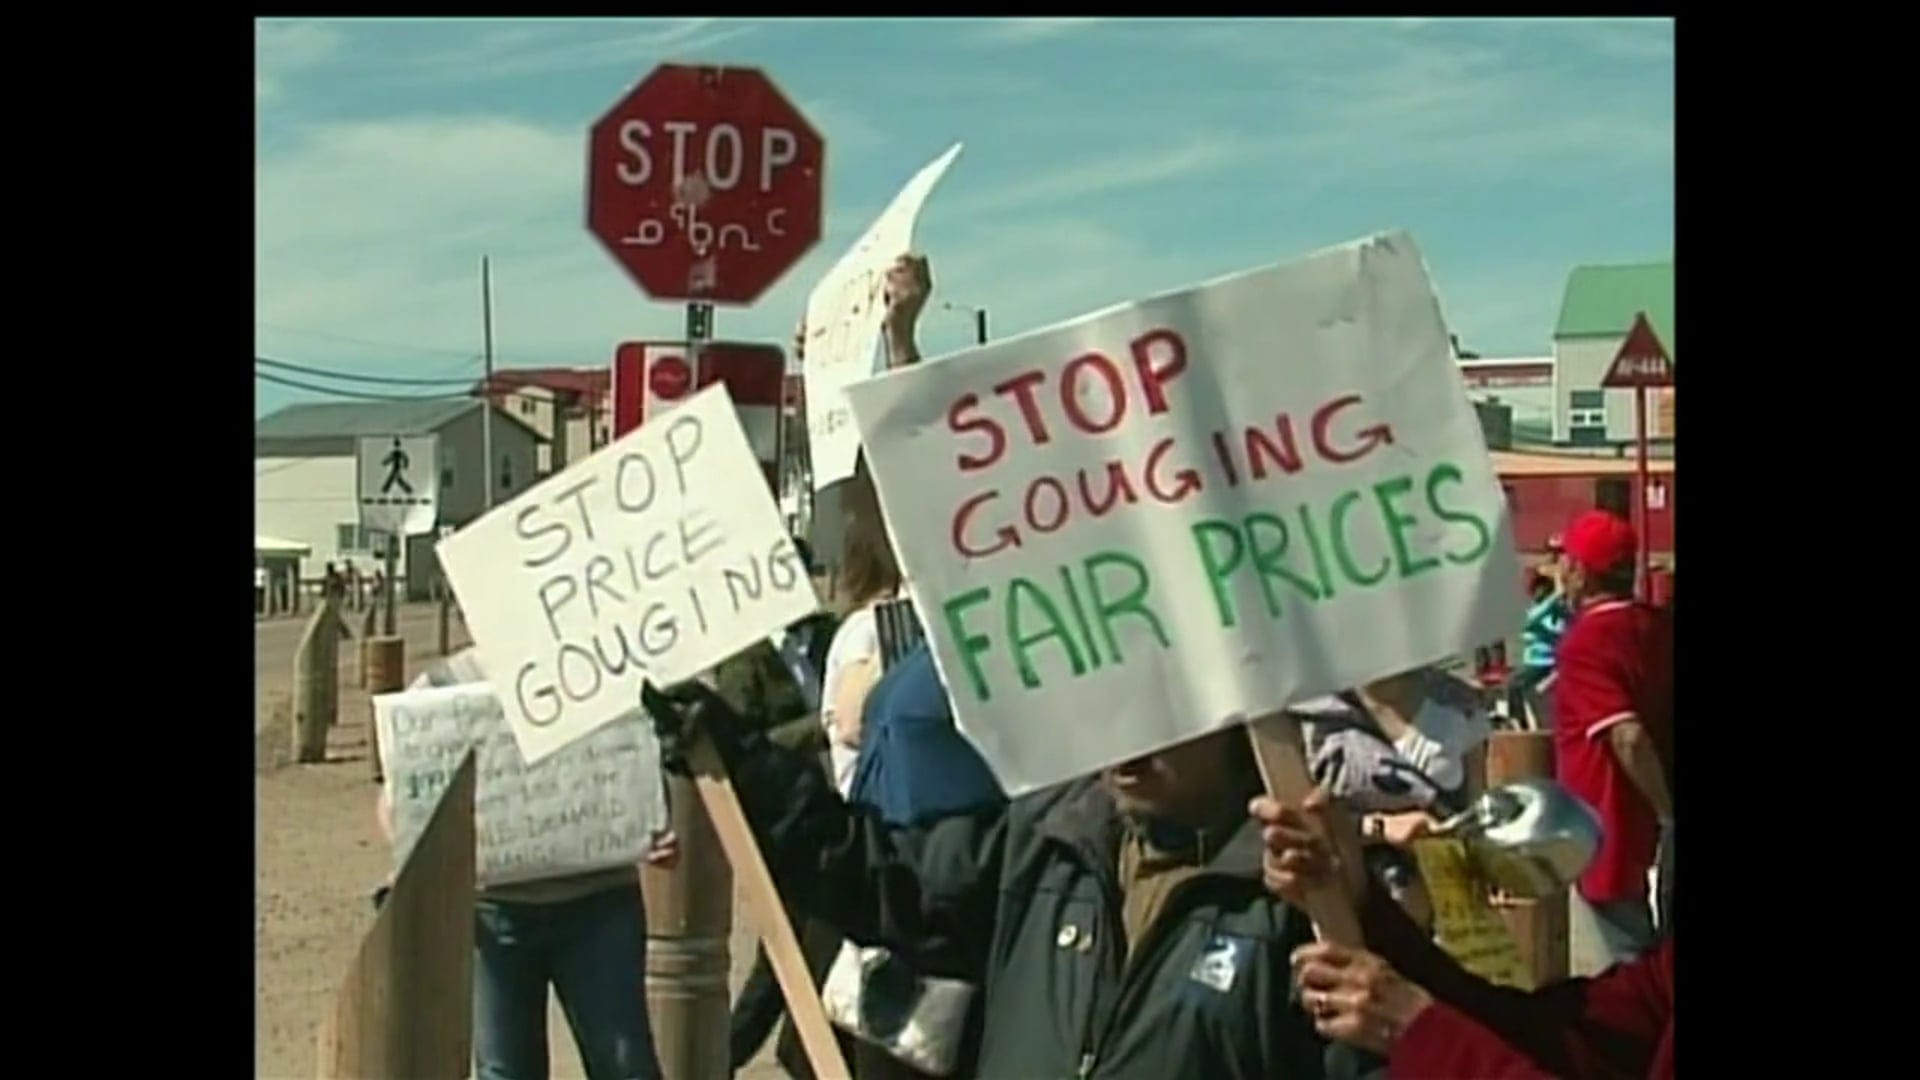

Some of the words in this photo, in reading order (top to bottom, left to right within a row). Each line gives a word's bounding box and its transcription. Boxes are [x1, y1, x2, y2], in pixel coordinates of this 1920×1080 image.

[616, 119, 797, 192] STOP
[947, 328, 1189, 472] STOP
[950, 396, 1397, 558] GOUGING
[515, 414, 703, 568] STOP
[515, 538, 800, 727] GOUGING
[538, 508, 727, 641] PRICE
[943, 551, 1171, 702] FAIR
[1191, 463, 1491, 628] PRICES
